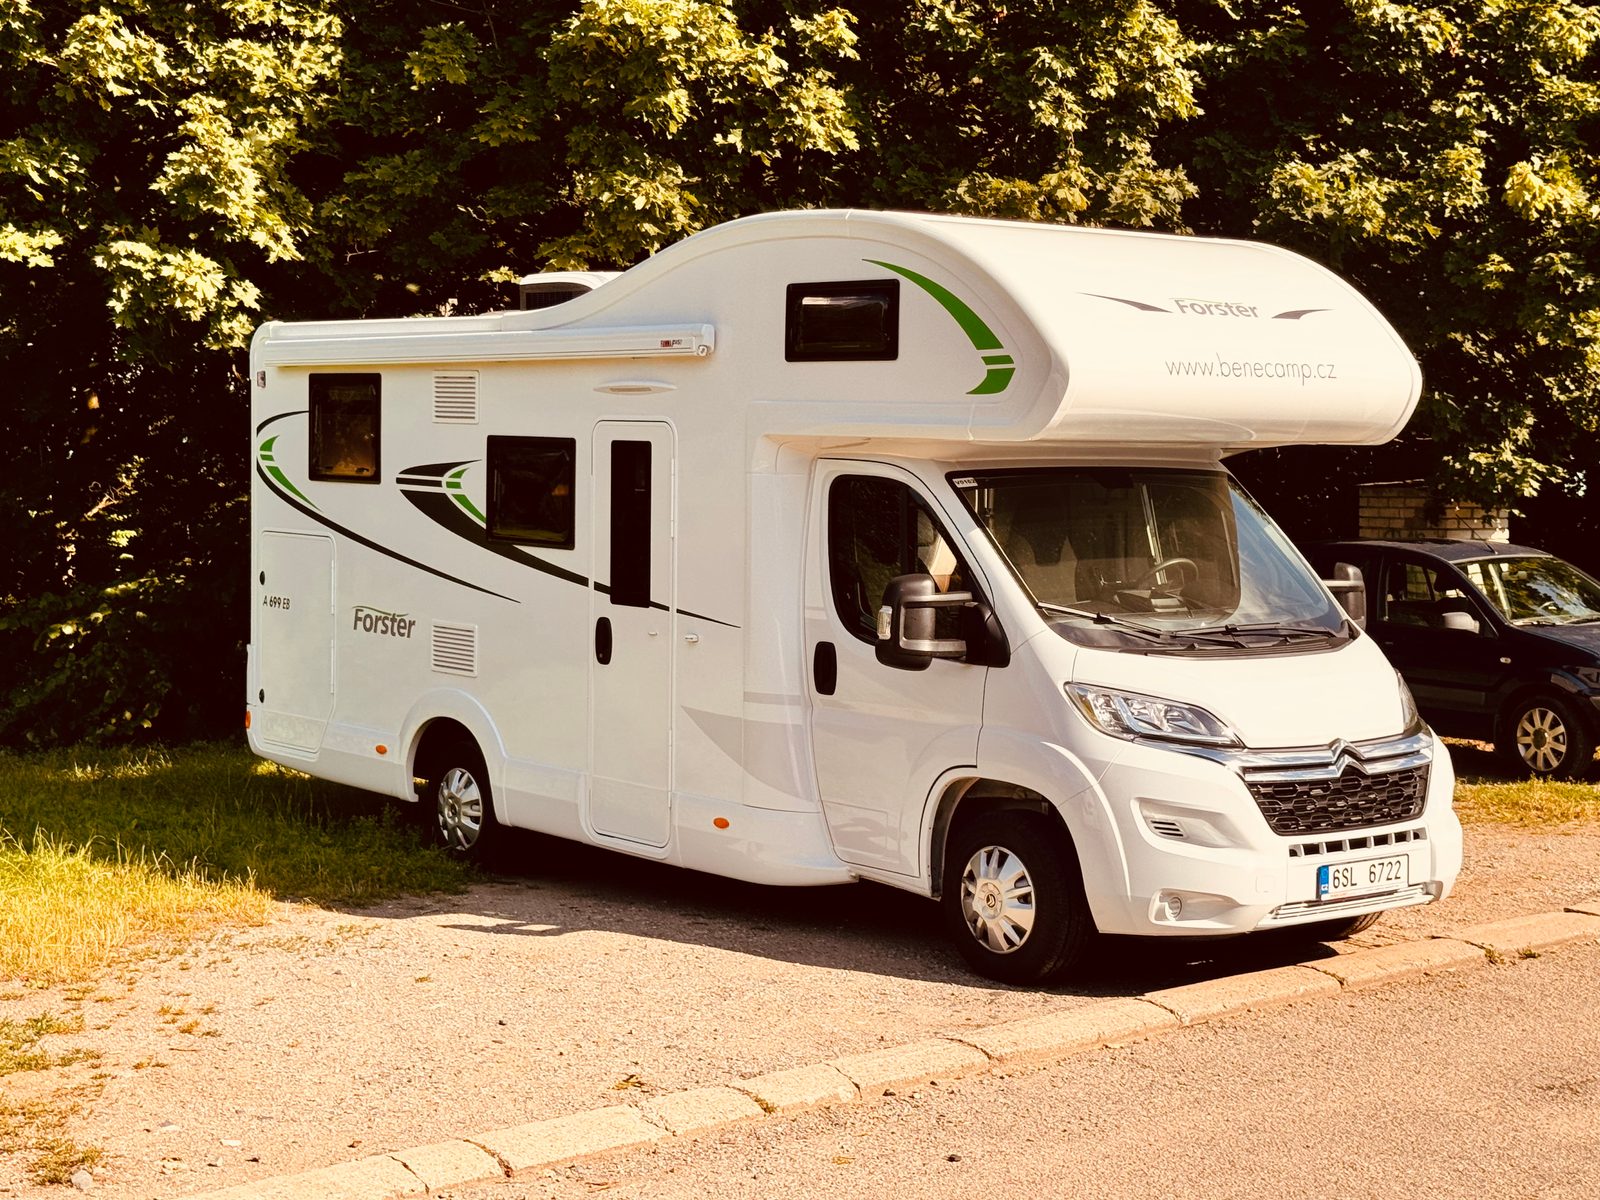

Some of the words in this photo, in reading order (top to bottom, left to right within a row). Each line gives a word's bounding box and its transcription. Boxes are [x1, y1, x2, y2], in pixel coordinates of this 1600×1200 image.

[1173, 299, 1259, 318] Forster
[1165, 352, 1337, 386] www.benecamp.cz
[263, 595, 268, 606] A
[269, 595, 282, 610] 699
[282, 597, 291, 610] EB
[353, 608, 416, 638] Forster
[1333, 867, 1357, 888] 6SL
[1369, 860, 1401, 883] 6722
